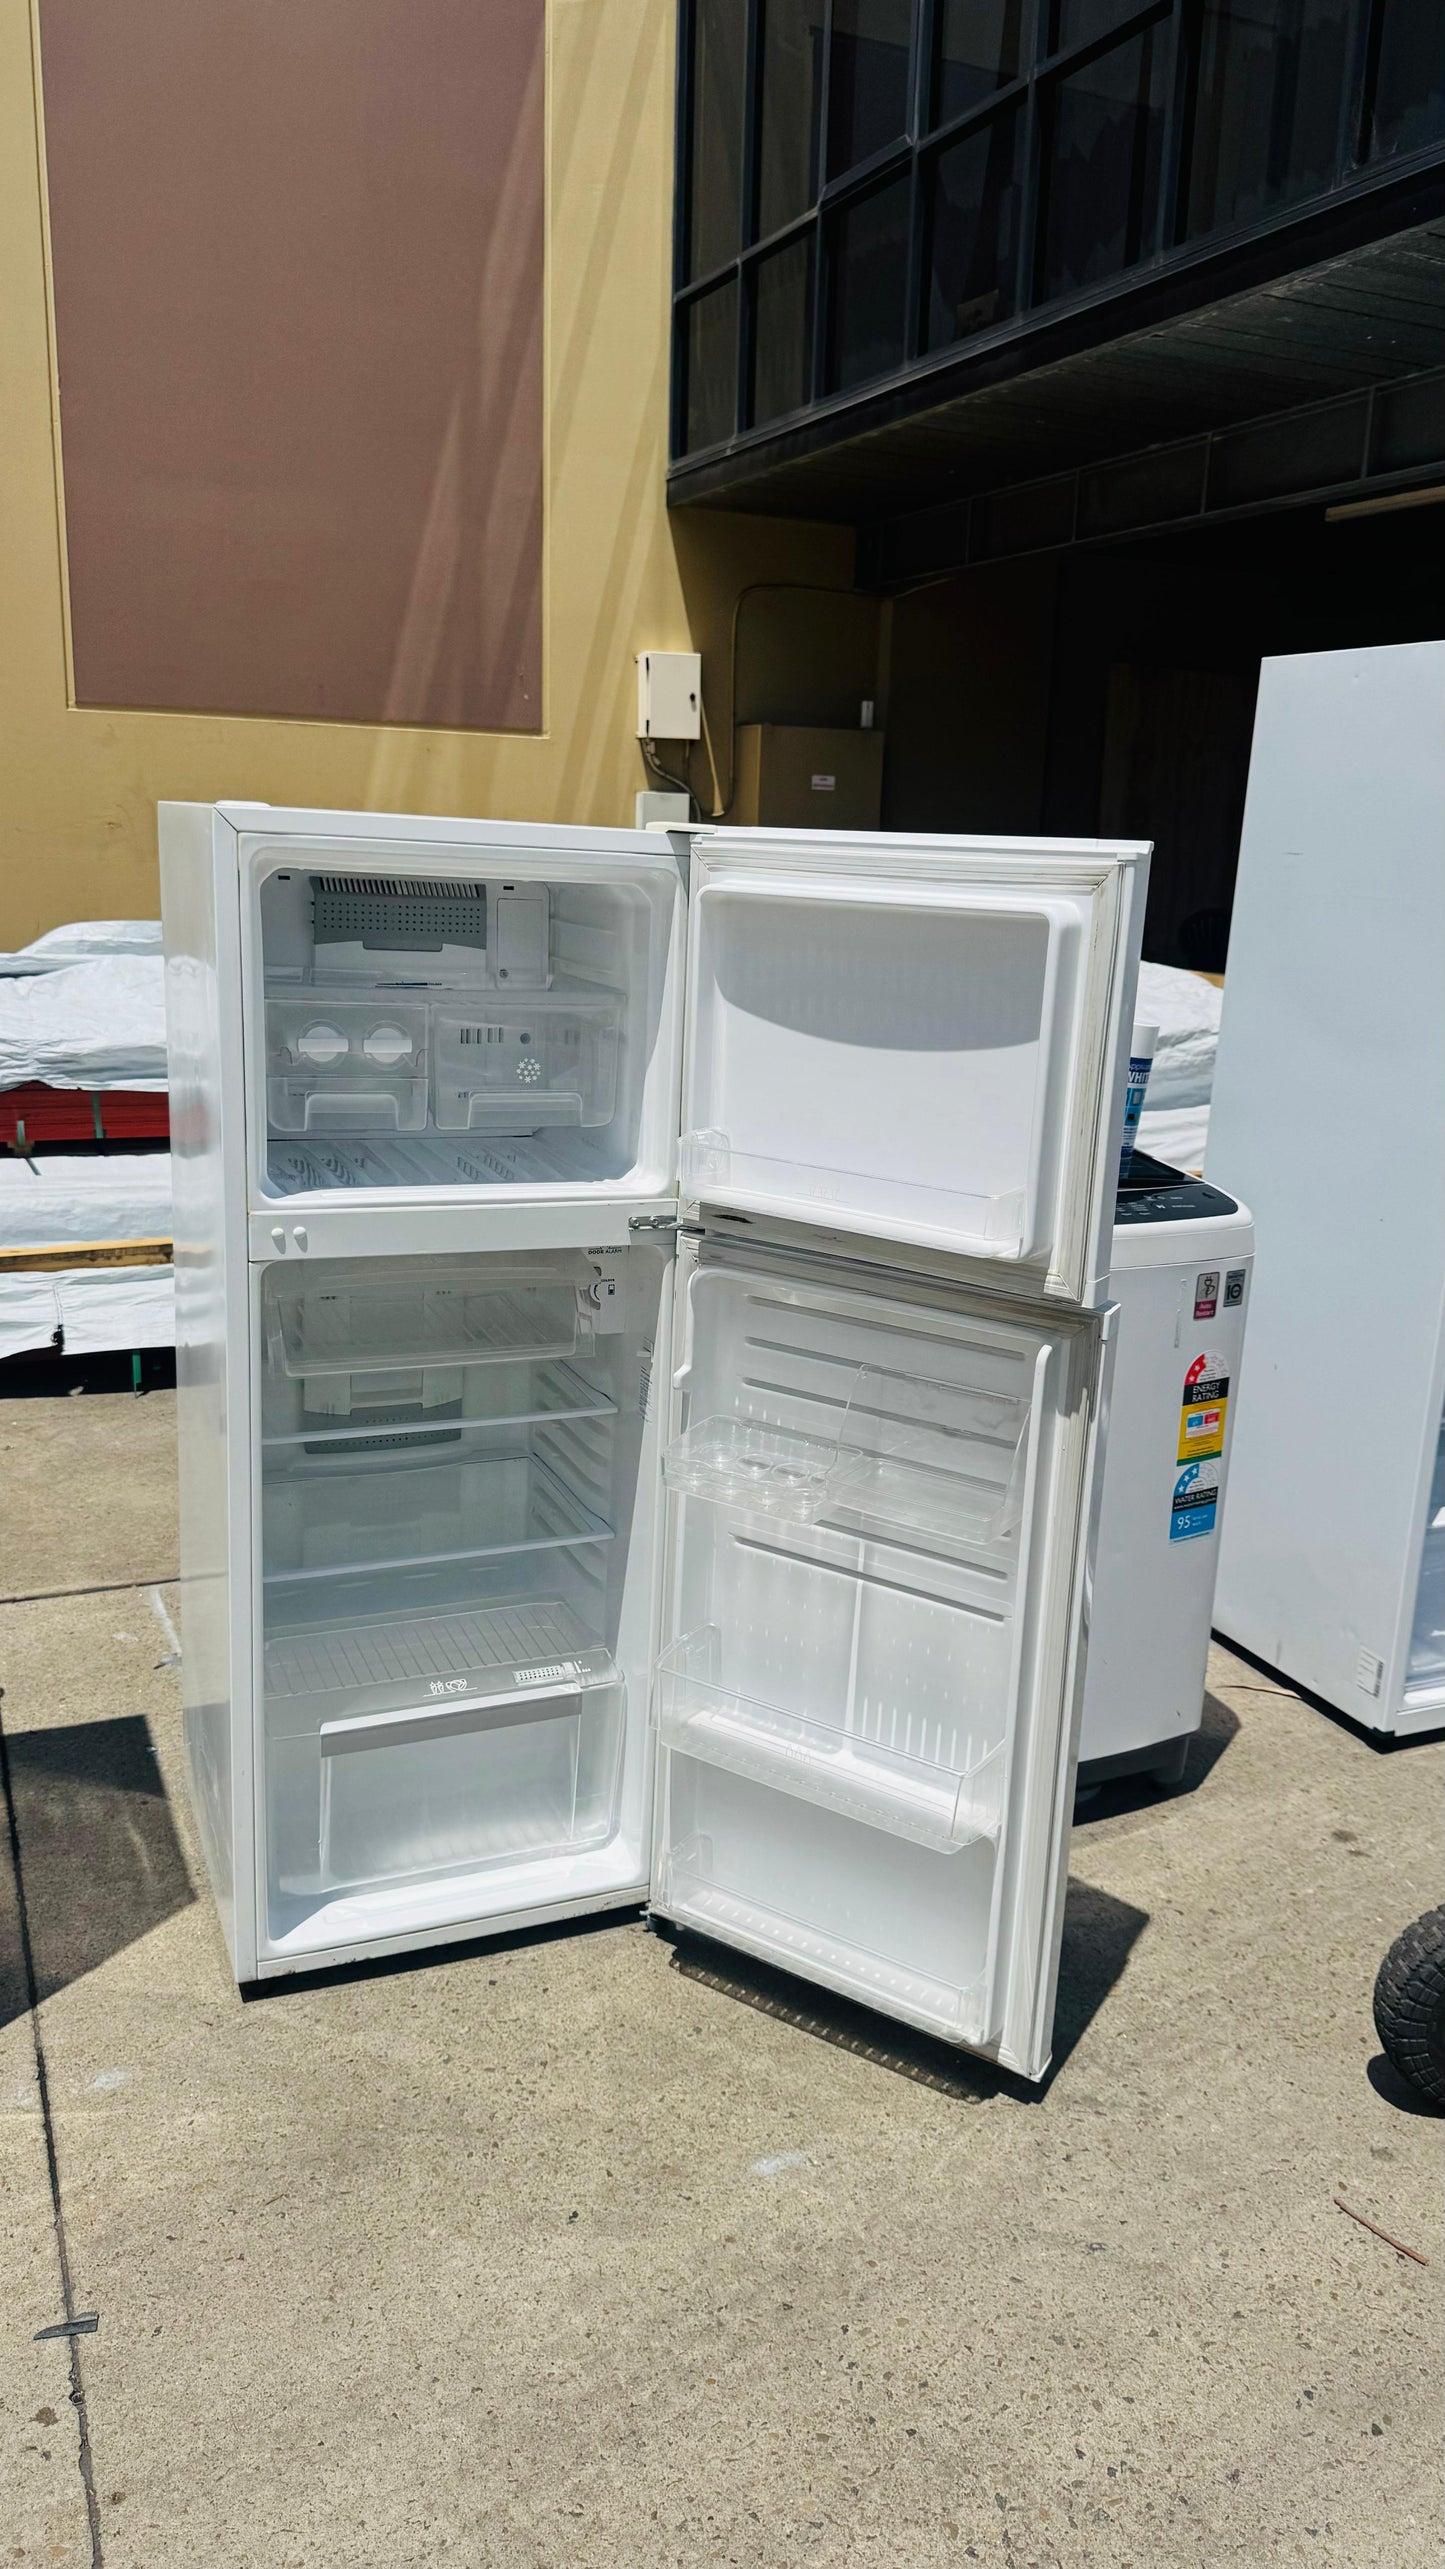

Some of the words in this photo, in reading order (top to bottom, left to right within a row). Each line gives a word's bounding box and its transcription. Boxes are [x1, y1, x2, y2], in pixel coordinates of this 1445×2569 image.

[1193, 1382, 1220, 1393] ENERGY
[1192, 1391, 1220, 1403] RATING
[1175, 1494, 1195, 1504] WATER
[1196, 1488, 1217, 1499] RATING
[1177, 1514, 1191, 1530] 95
